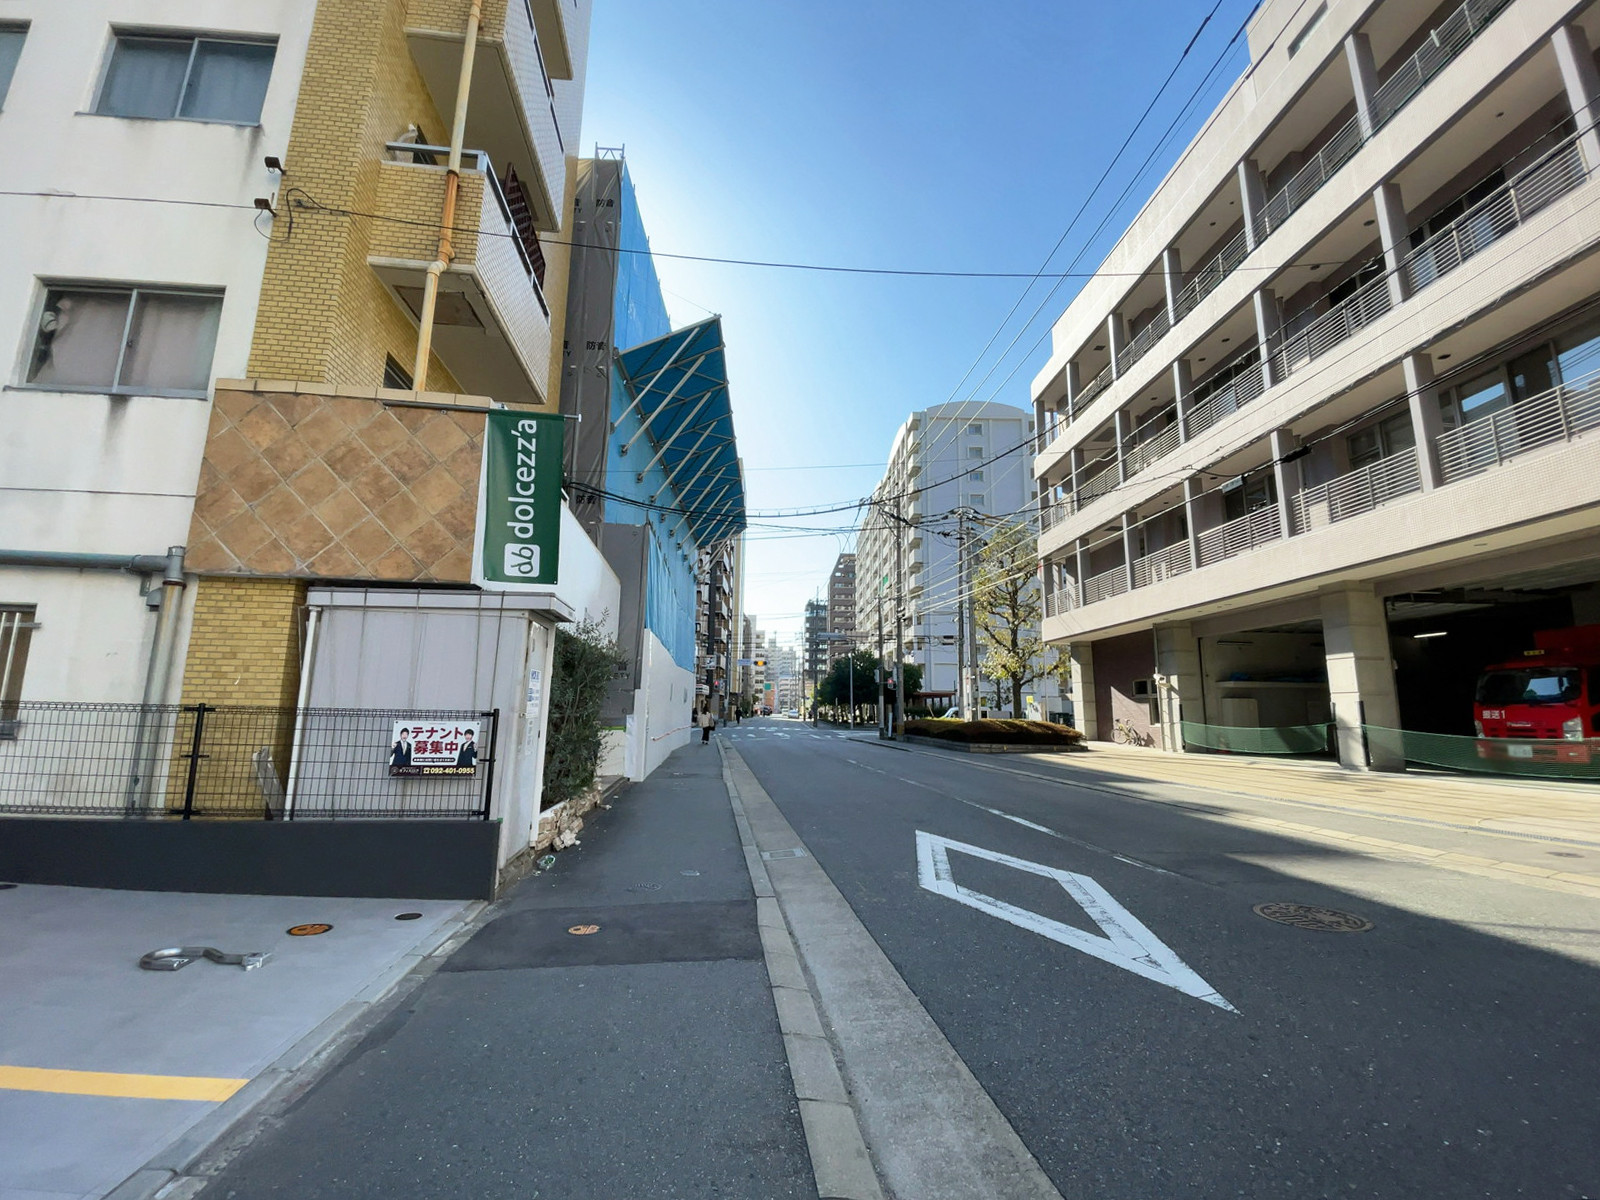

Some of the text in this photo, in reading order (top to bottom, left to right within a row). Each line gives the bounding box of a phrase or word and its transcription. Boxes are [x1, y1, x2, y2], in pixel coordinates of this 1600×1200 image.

[411, 726, 463, 740] テナント
[414, 740, 459, 755] 募集中
[430, 767, 475, 775] 092-401-0955
